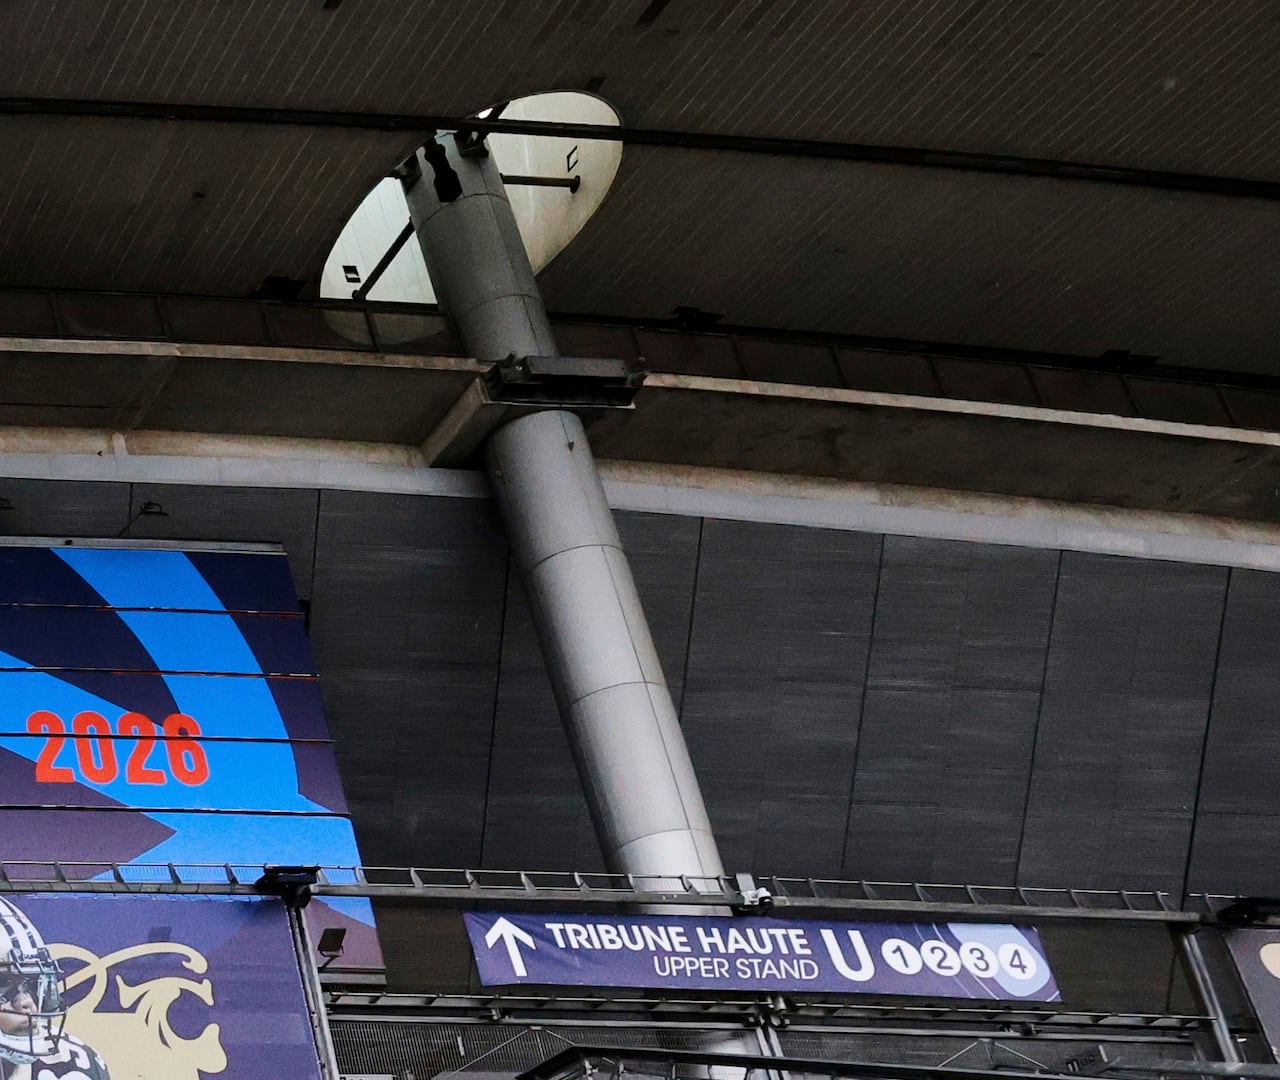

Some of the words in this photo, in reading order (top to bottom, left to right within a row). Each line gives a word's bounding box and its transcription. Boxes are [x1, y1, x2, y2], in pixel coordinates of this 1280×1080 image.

[26, 711, 210, 786] 2026
[545, 923, 692, 953] TRIBUNE
[696, 926, 813, 955] HAUTE
[820, 928, 875, 982] U
[892, 945, 909, 968] 1
[930, 946, 953, 970] 2
[969, 948, 989, 972] 3
[1009, 949, 1027, 973] 4
[653, 956, 730, 978] UPPER
[736, 958, 819, 980] STAND
